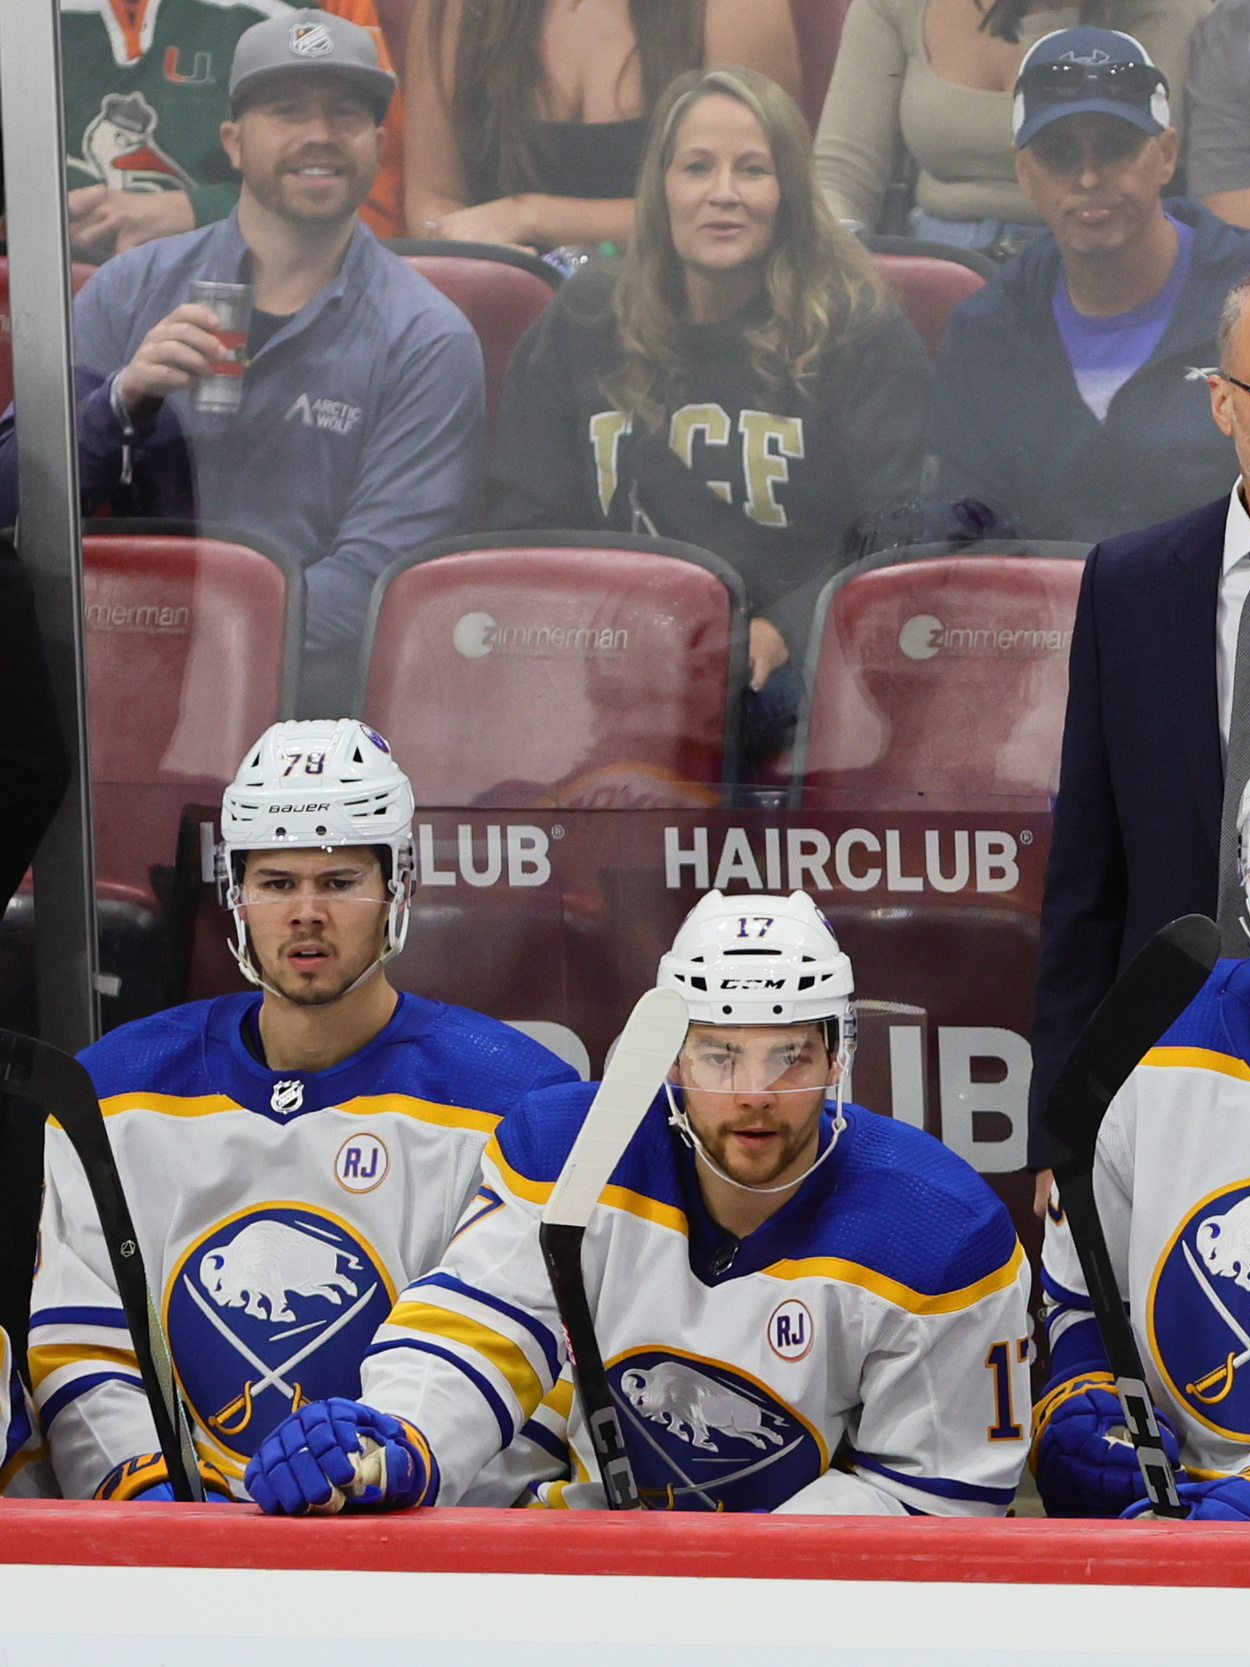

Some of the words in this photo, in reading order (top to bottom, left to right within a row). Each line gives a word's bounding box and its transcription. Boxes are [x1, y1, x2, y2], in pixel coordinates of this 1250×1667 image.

[312, 398, 363, 422] ARCTIC
[316, 413, 353, 436] WOLF
[85, 604, 189, 627] merman
[481, 624, 629, 650] zimmerman
[282, 752, 326, 777] 78
[268, 803, 330, 814] BAUER
[737, 917, 775, 938] 17
[342, 1147, 379, 1179] RJ
[776, 1312, 805, 1348] RJ
